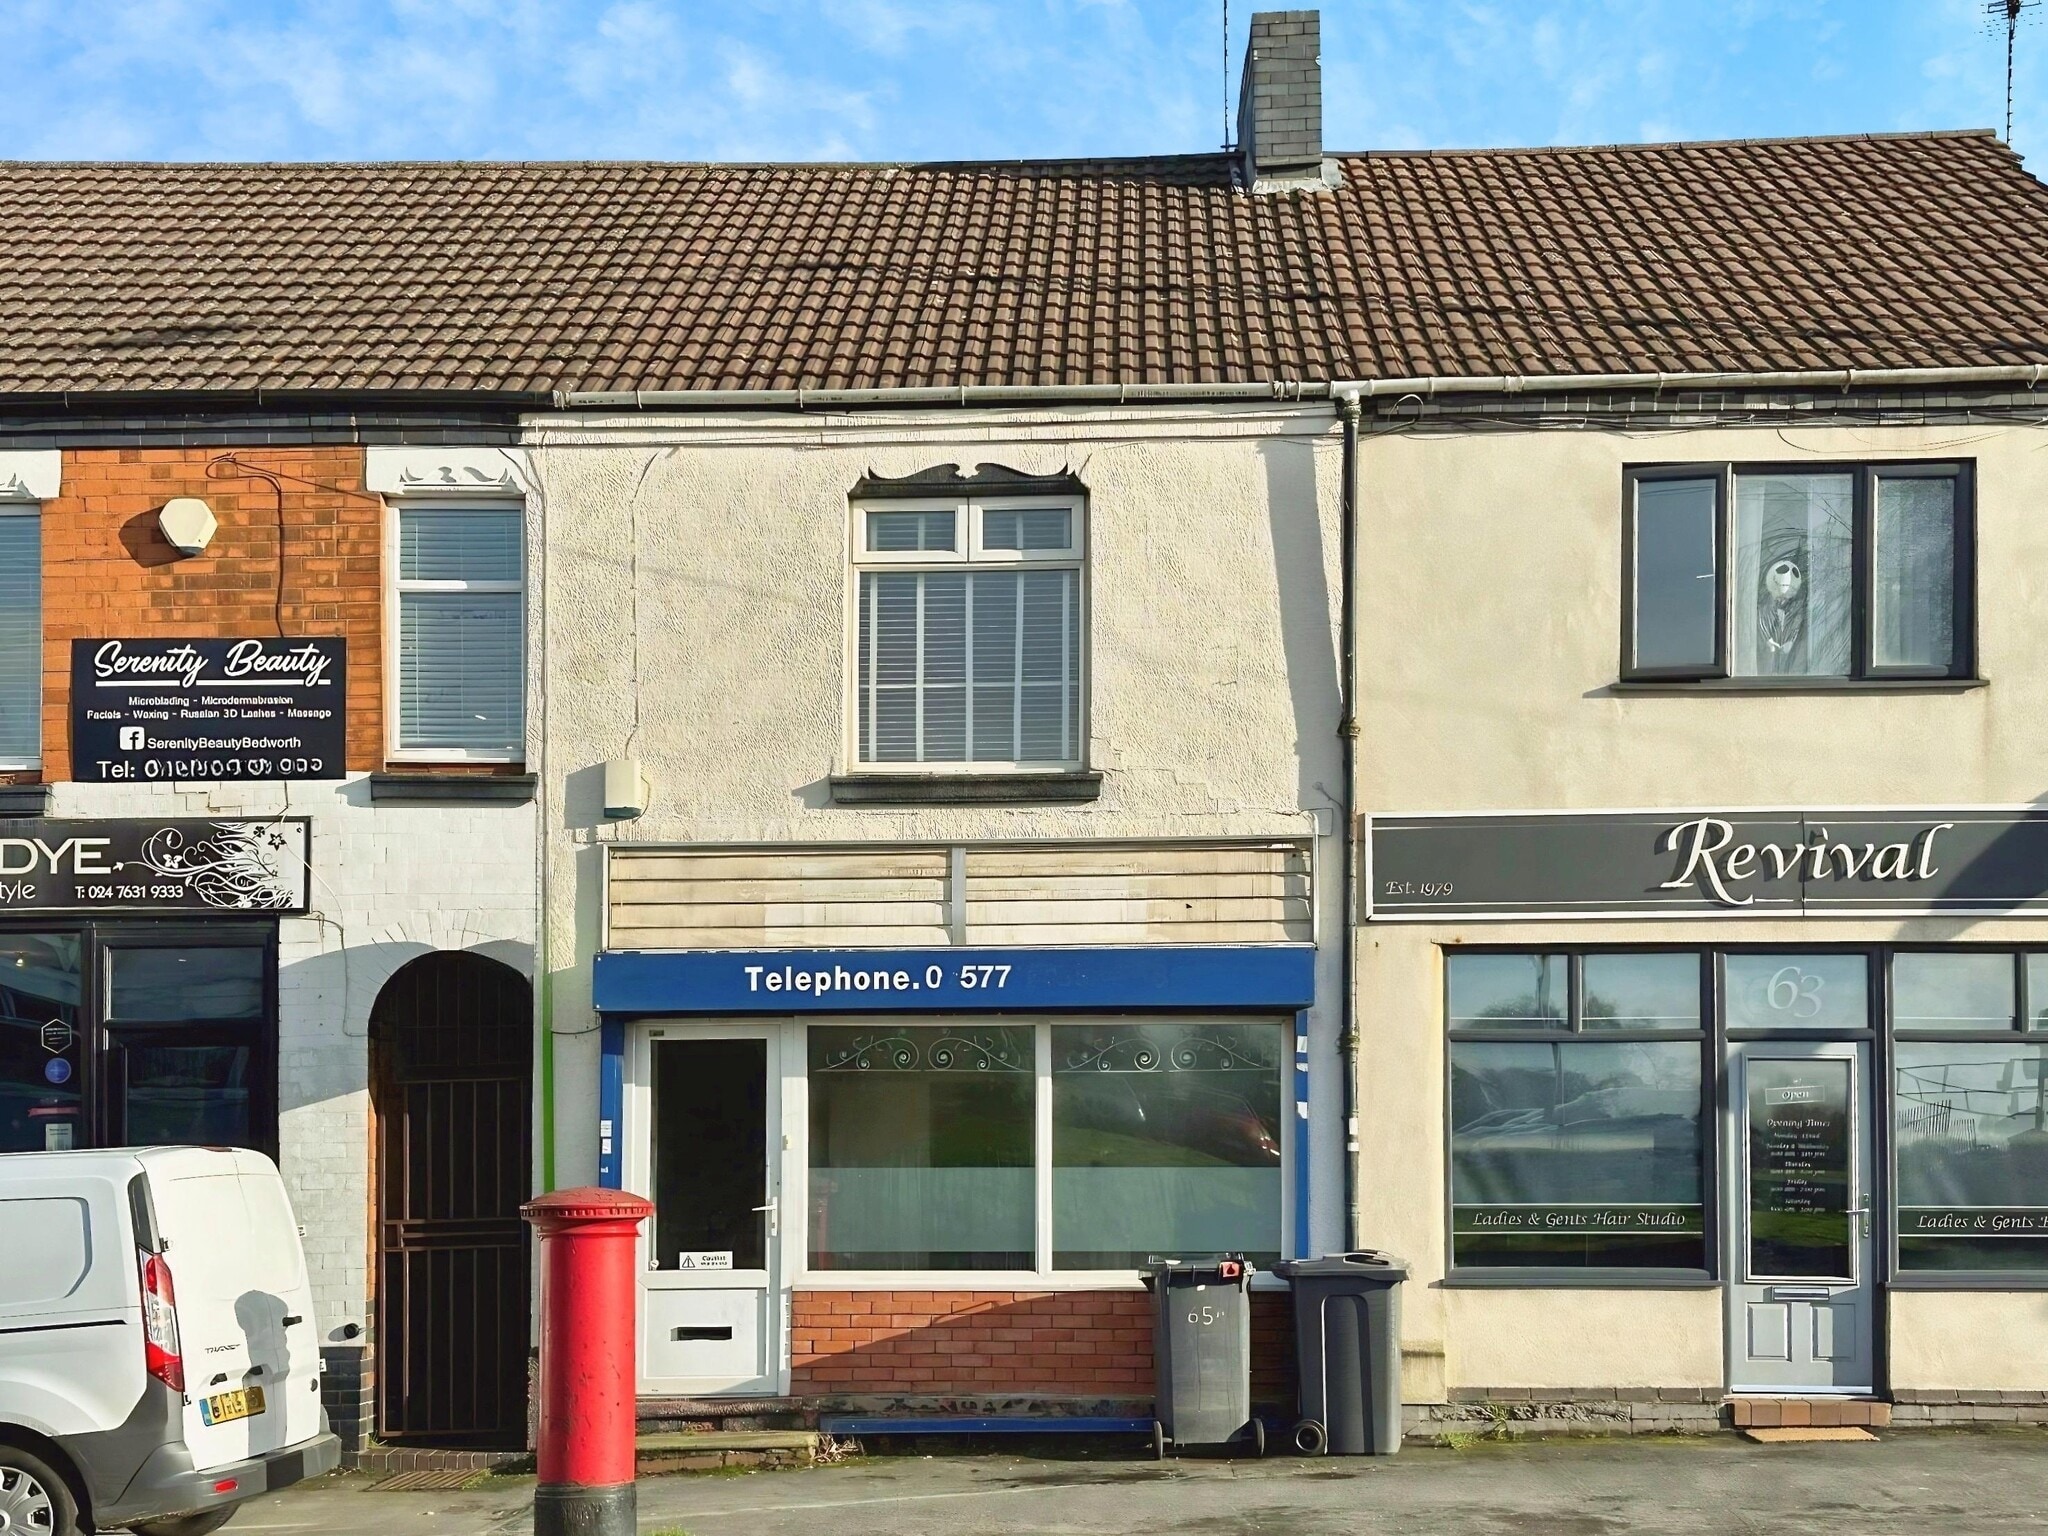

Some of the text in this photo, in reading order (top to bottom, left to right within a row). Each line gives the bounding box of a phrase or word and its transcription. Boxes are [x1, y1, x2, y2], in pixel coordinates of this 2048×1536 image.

[94, 639, 332, 688] Serenity Beauty
[224, 709, 238, 718] 3D
[147, 737, 301, 750] SerenityBeautyBedworth
[97, 761, 136, 778] Tel:
[1660, 817, 1954, 905] Revival
[75, 886, 183, 898] T: 024 7631 9333
[1385, 881, 1453, 896] Est. 1979
[960, 965, 1012, 988] 577
[1767, 966, 1824, 1018] 63
[1782, 1091, 1808, 1101] Open
[1473, 1211, 1685, 1227] Ladies & Gents Hair Studio
[1917, 1213, 1969, 1228] Ladies
[1974, 1215, 1986, 1228] &
[1992, 1215, 2034, 1231] Gents
